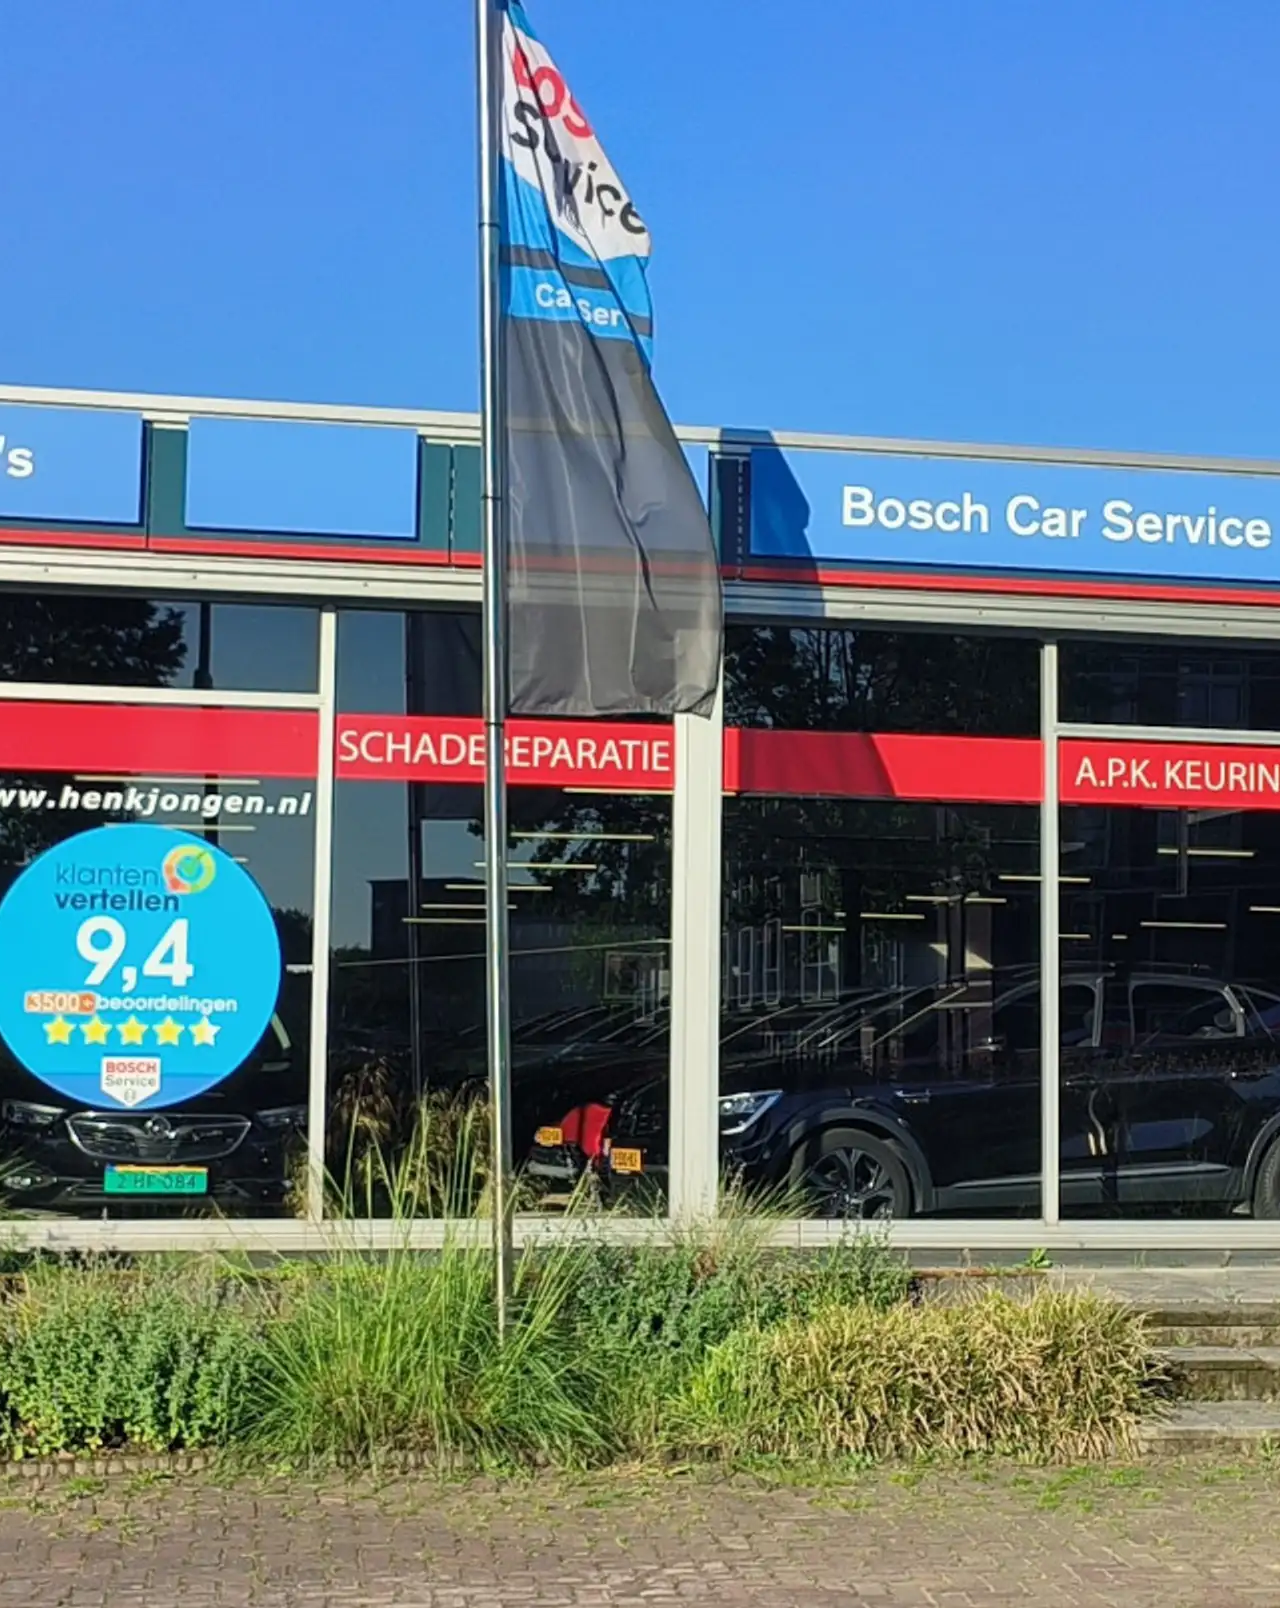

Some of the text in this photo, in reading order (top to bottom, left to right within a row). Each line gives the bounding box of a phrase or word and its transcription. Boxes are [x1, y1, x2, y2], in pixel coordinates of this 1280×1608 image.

[535, 282, 573, 308] Ca
[841, 484, 1272, 549] Bosch Car Service
[1075, 757, 1158, 789] A.P.K.
[56, 863, 159, 887] klanten
[55, 889, 180, 912] vertellen
[76, 915, 194, 993] 9,4
[97, 994, 237, 1016] beoordelingen
[106, 1062, 156, 1073] BOSCH
